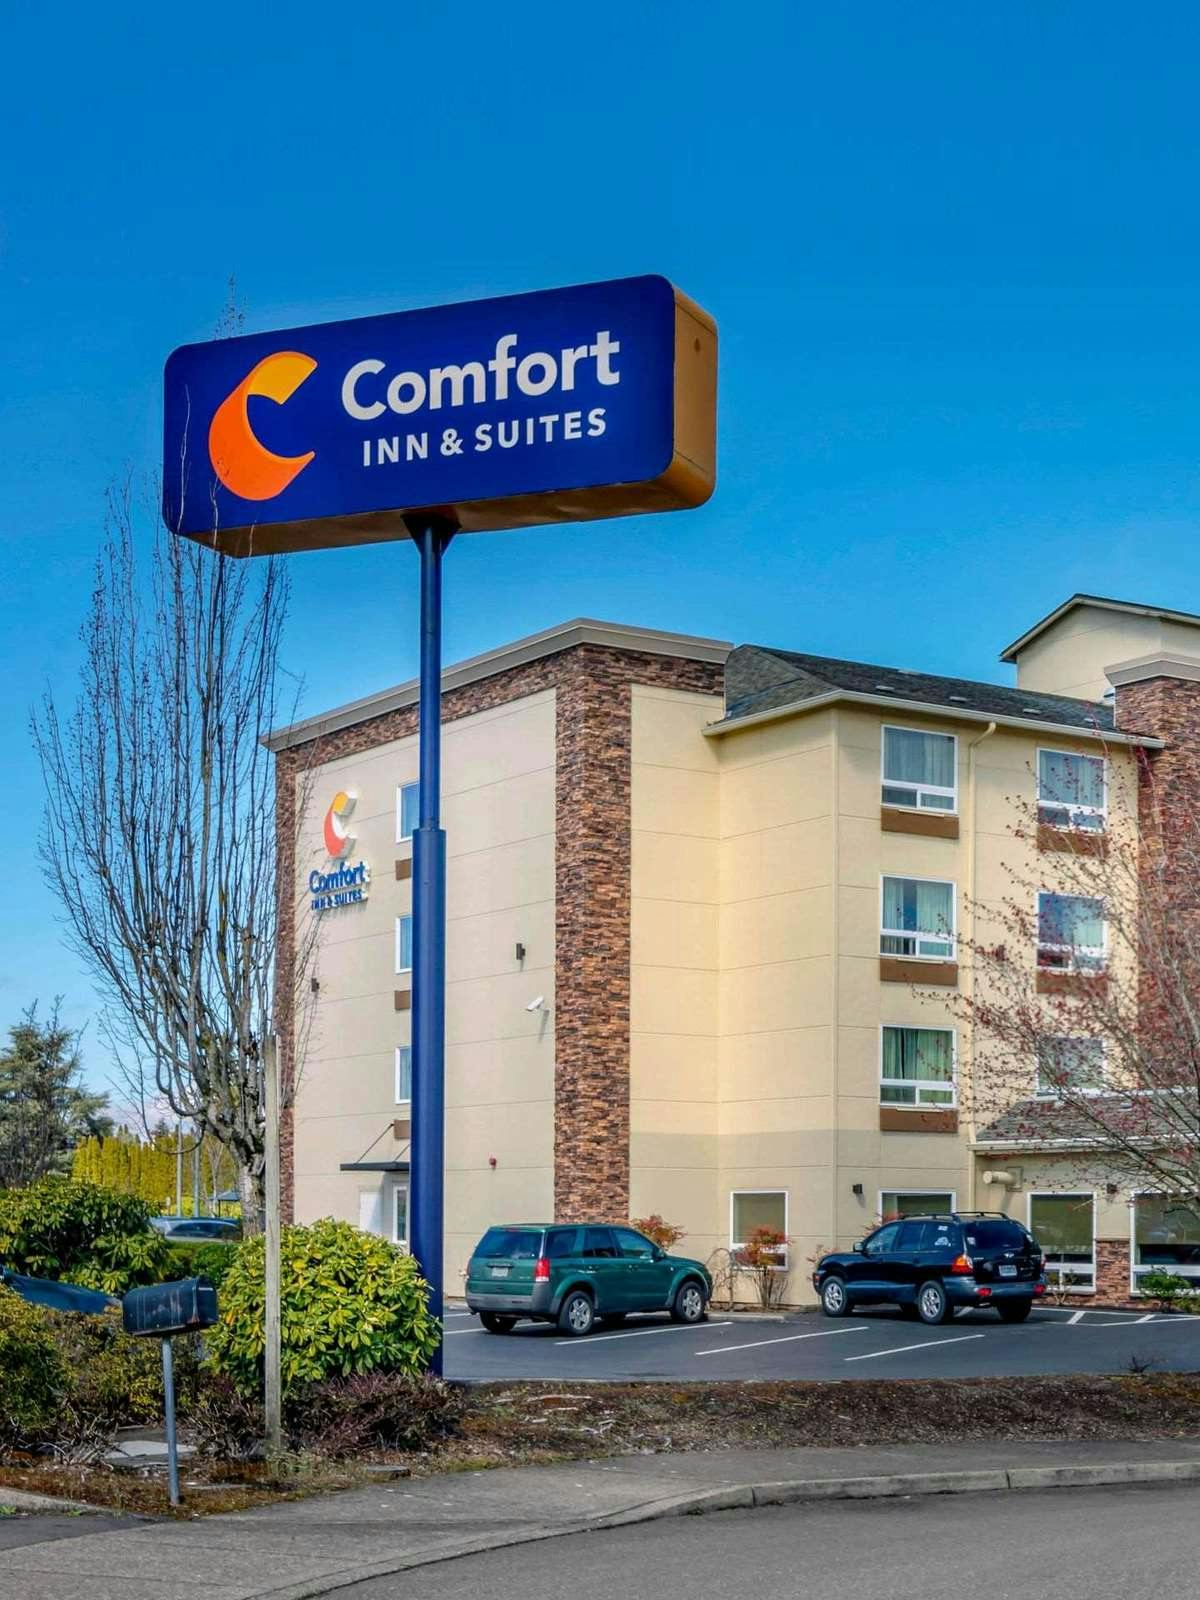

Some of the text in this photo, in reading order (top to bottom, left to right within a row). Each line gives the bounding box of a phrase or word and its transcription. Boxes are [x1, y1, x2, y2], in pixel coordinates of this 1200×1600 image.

[341, 330, 620, 421] Comfort
[363, 408, 606, 467] INN & SUITES
[309, 861, 365, 893] Comfort
